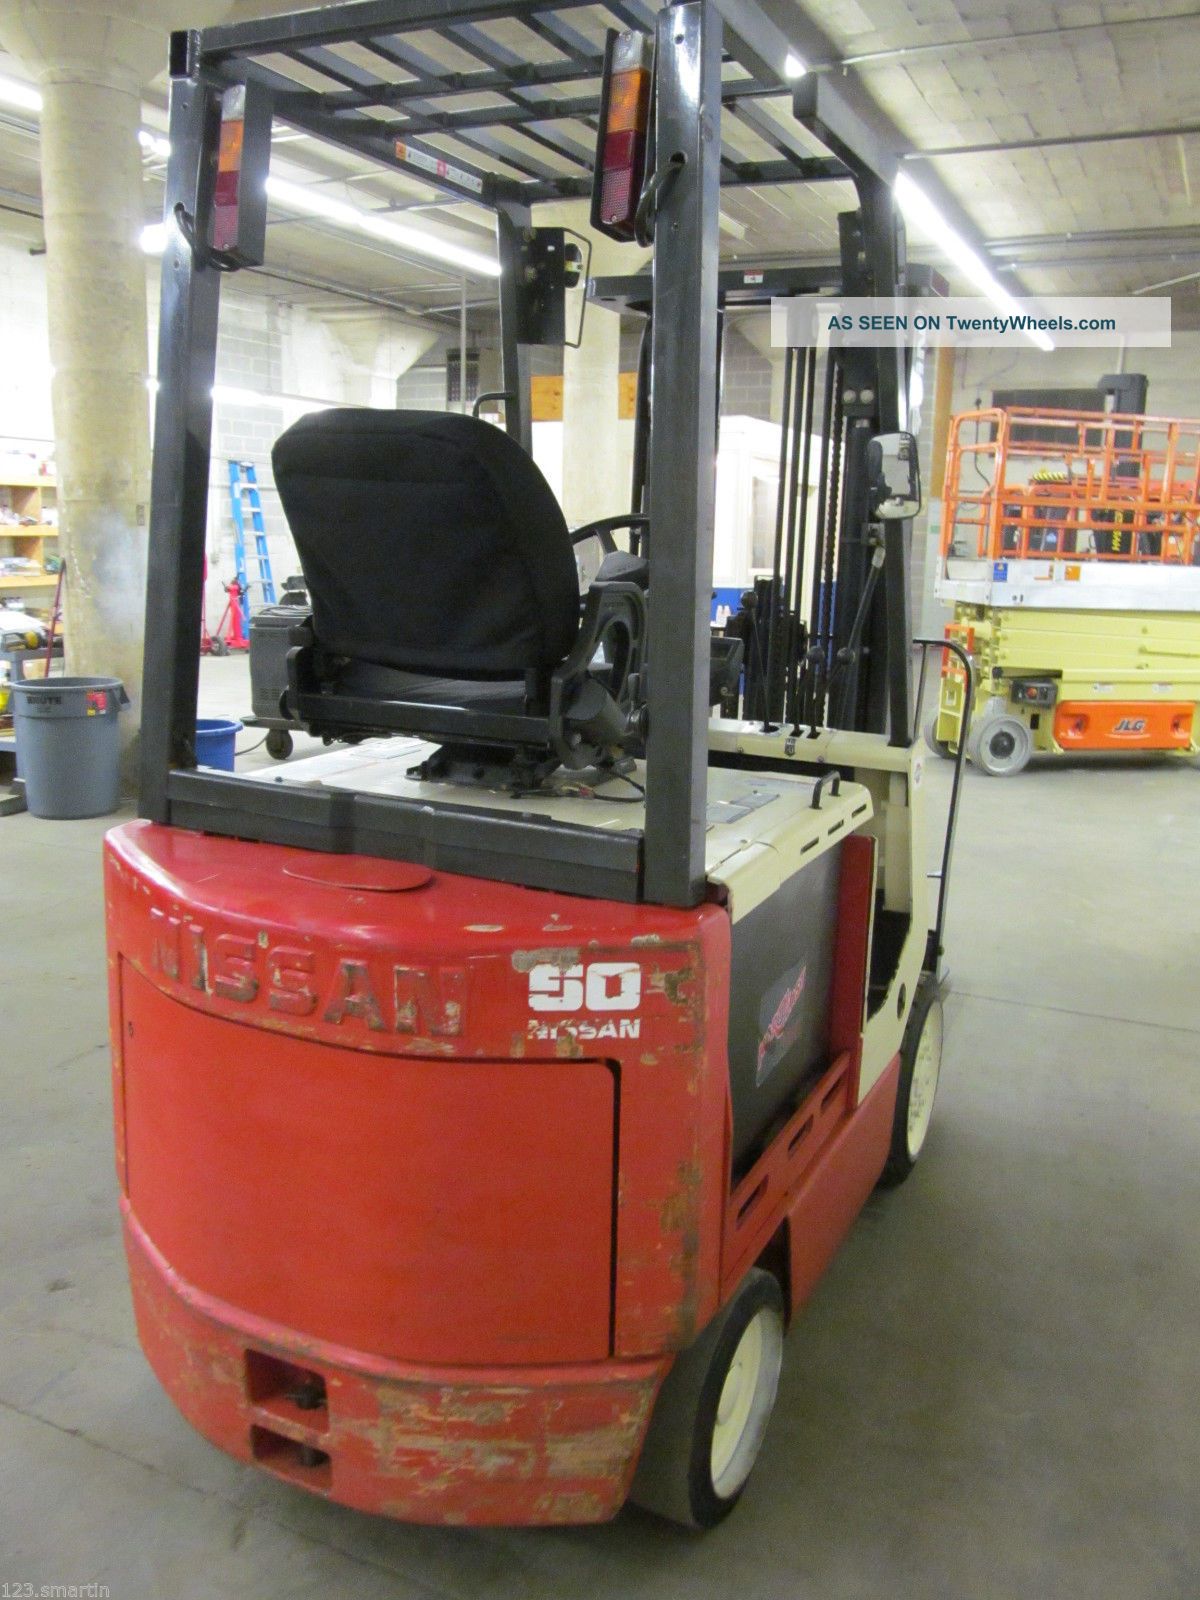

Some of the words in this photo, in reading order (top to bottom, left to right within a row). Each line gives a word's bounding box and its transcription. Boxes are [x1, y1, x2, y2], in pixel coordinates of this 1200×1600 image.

[1113, 717, 1146, 732] JLG
[150, 907, 466, 1037] NISSAN
[528, 962, 641, 1012] 50
